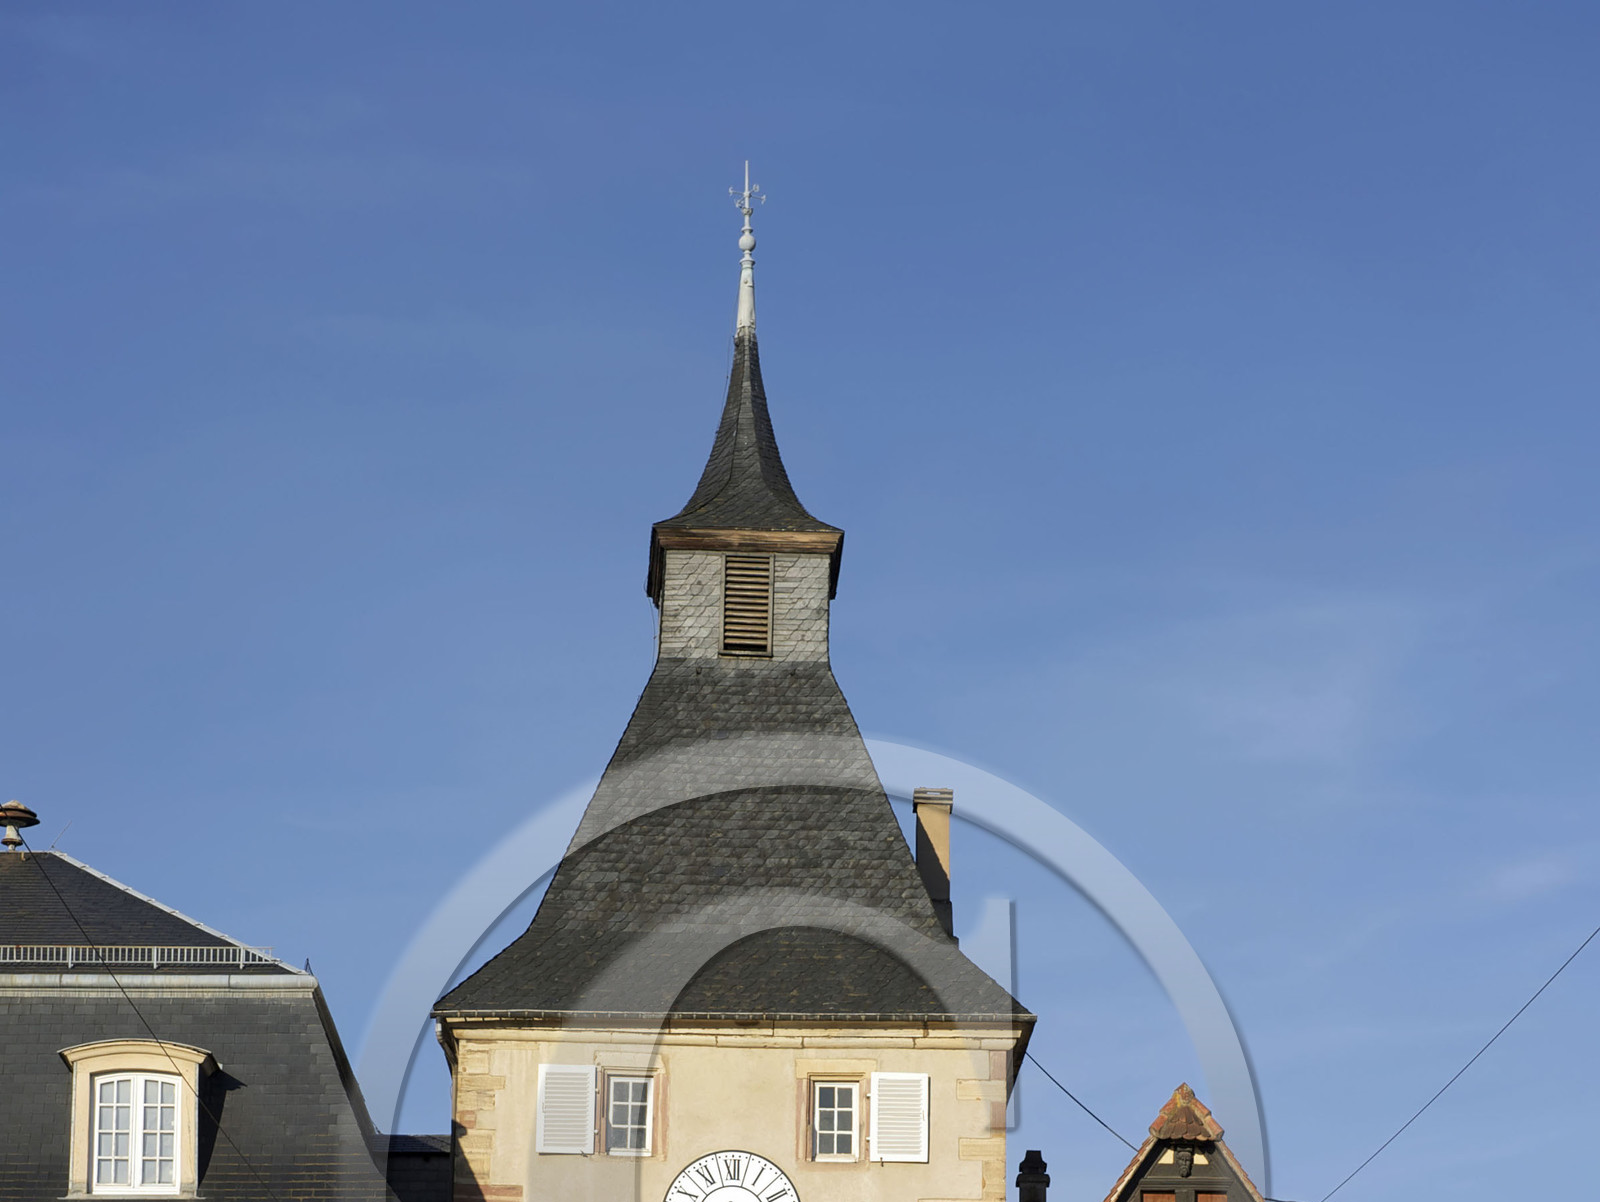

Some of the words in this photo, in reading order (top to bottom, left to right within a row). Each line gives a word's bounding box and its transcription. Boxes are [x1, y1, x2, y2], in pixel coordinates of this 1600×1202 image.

[696, 1165, 716, 1188] XI
[724, 1159, 741, 1181] XII
[751, 1167, 765, 1186] I
[677, 1186, 699, 1202] X
